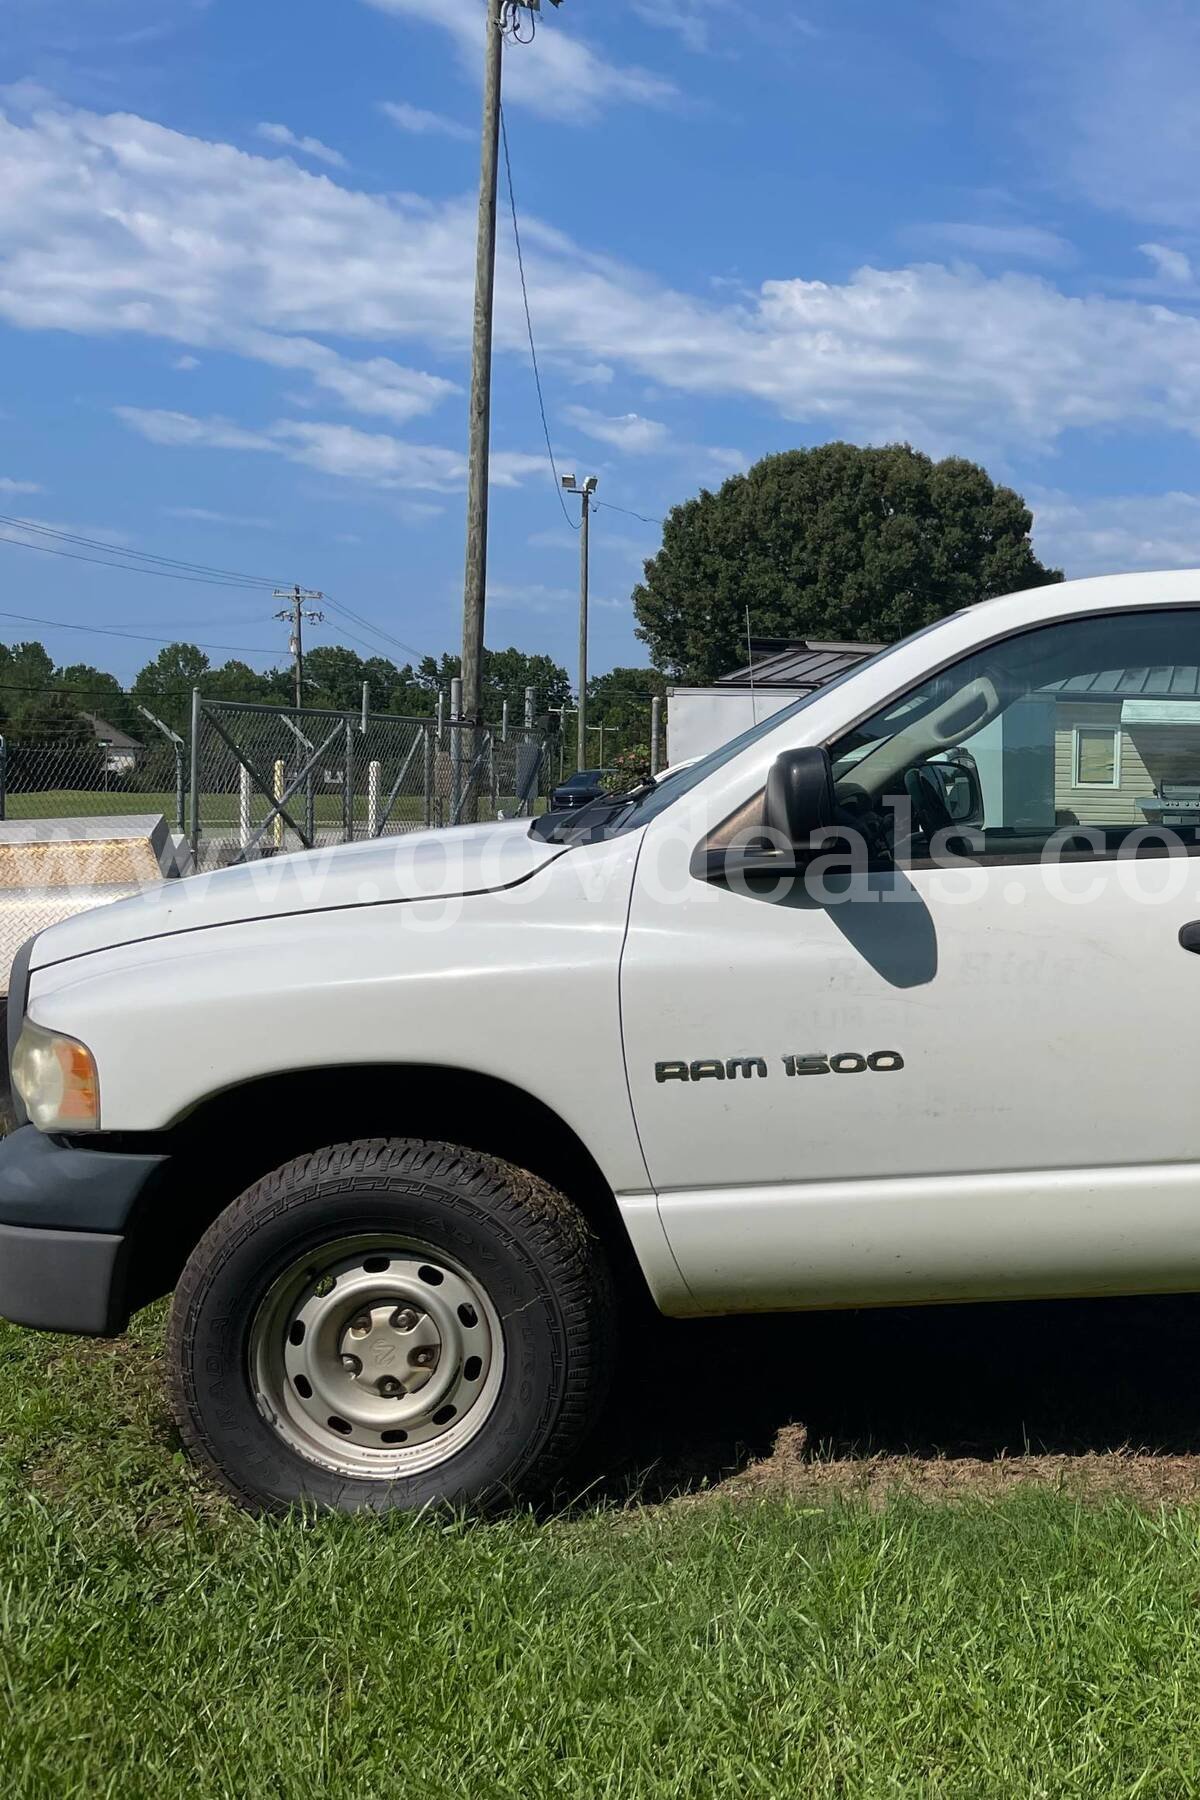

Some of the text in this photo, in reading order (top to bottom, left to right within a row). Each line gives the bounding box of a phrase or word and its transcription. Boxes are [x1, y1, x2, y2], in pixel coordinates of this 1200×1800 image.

[654, 1050, 905, 1083] RAM 1500
[205, 1295, 240, 1431] RADIAL
